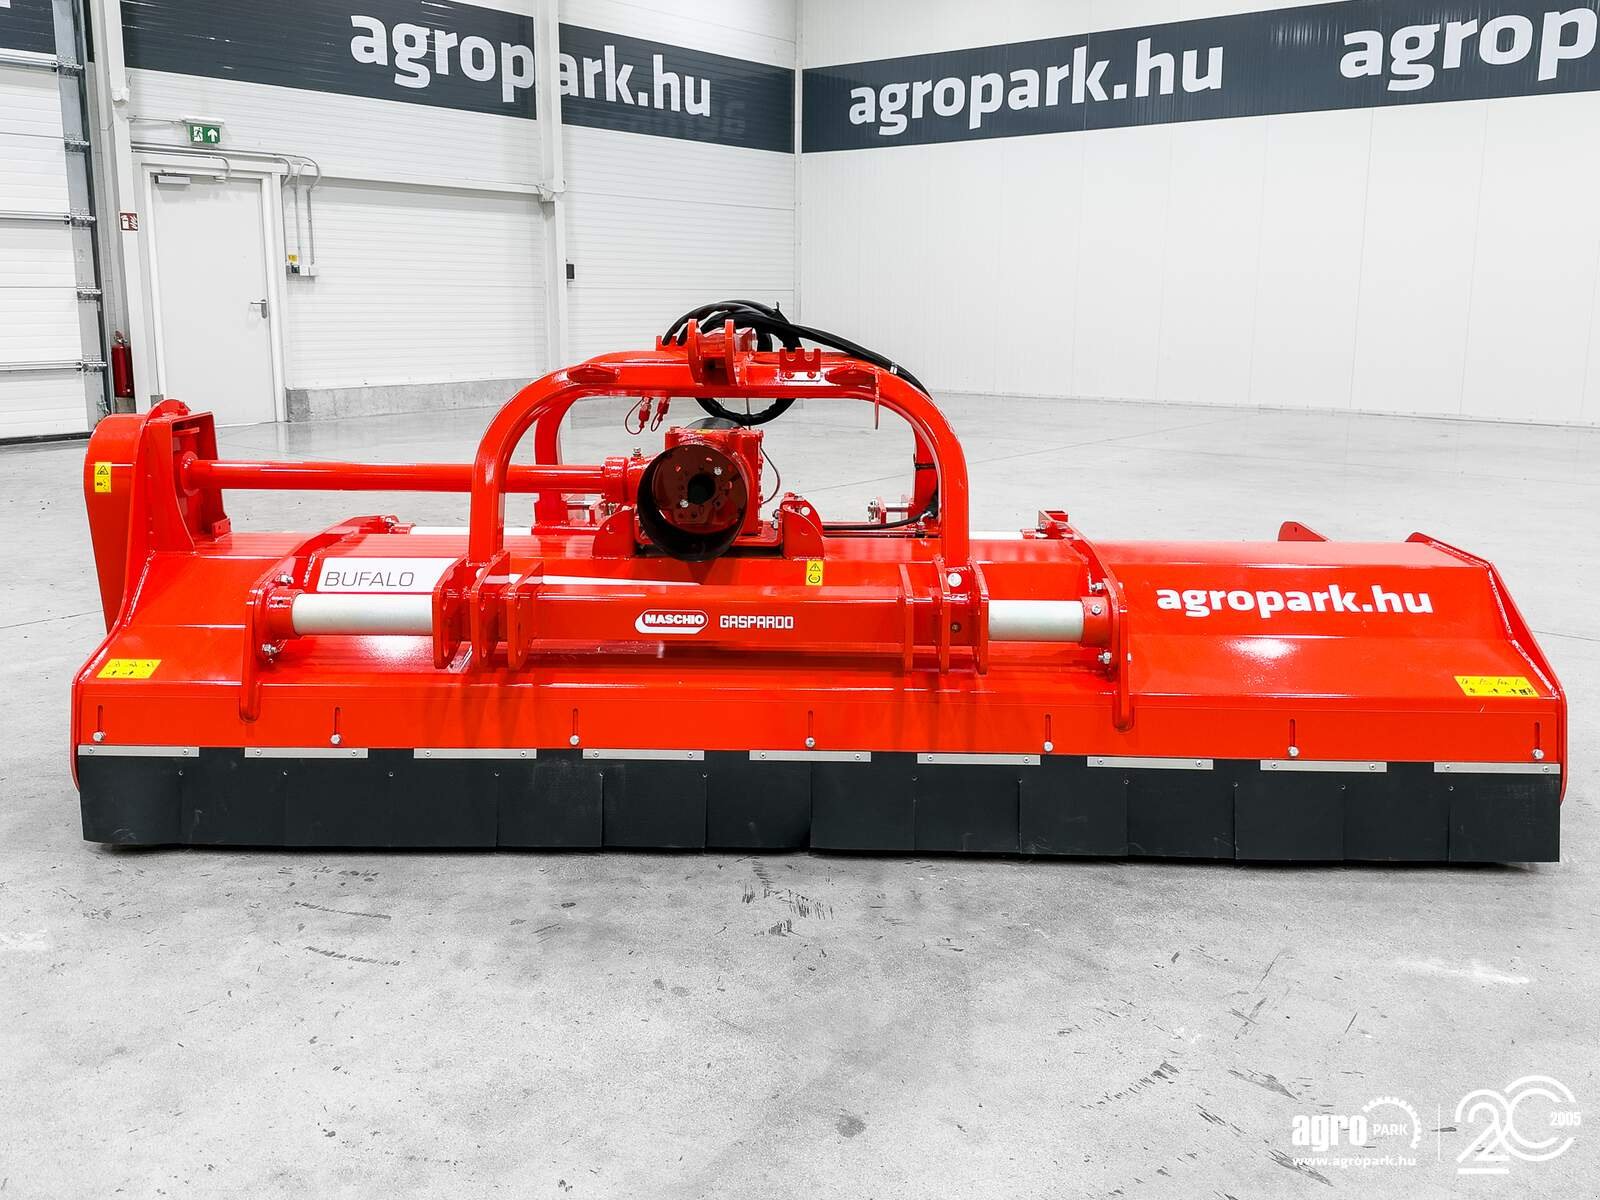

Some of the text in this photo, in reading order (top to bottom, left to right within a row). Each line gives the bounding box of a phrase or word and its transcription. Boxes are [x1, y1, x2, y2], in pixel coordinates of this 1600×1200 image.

[1339, 7, 1598, 92] agrop
[848, 37, 1224, 136] agropark.hu
[324, 571, 415, 587] BUFALO
[1156, 584, 1433, 619] agropark.hu
[644, 614, 794, 629] MASCHIO GASPARDO
